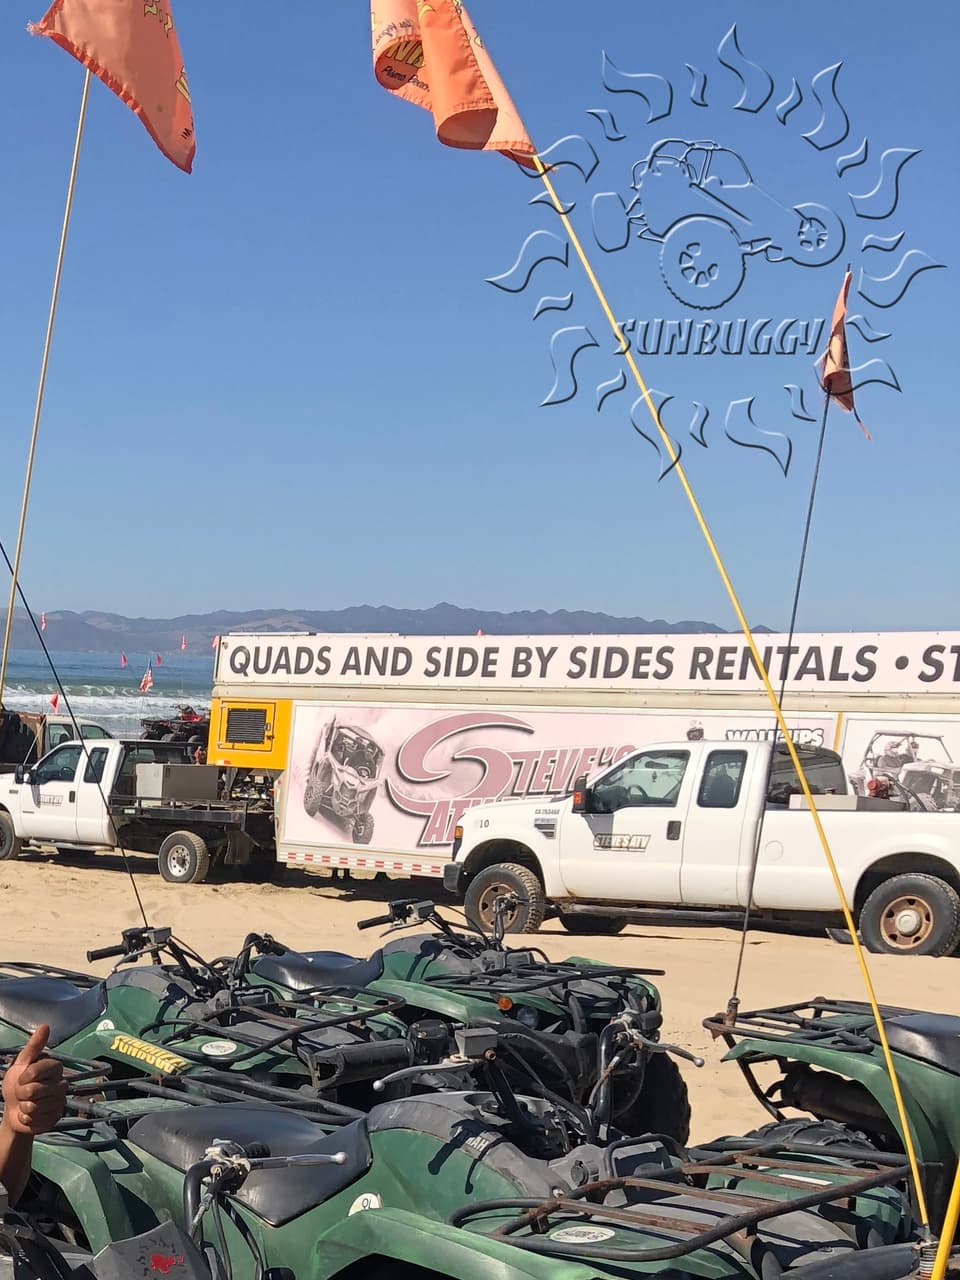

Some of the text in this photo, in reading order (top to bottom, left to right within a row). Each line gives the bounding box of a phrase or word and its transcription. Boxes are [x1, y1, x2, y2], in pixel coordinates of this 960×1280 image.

[229, 646, 331, 677] QUADS
[340, 646, 413, 677] AND
[423, 646, 500, 678] SIDE
[511, 646, 559, 679] BY
[566, 645, 674, 680] SIDES
[688, 645, 879, 682] RENTALS
